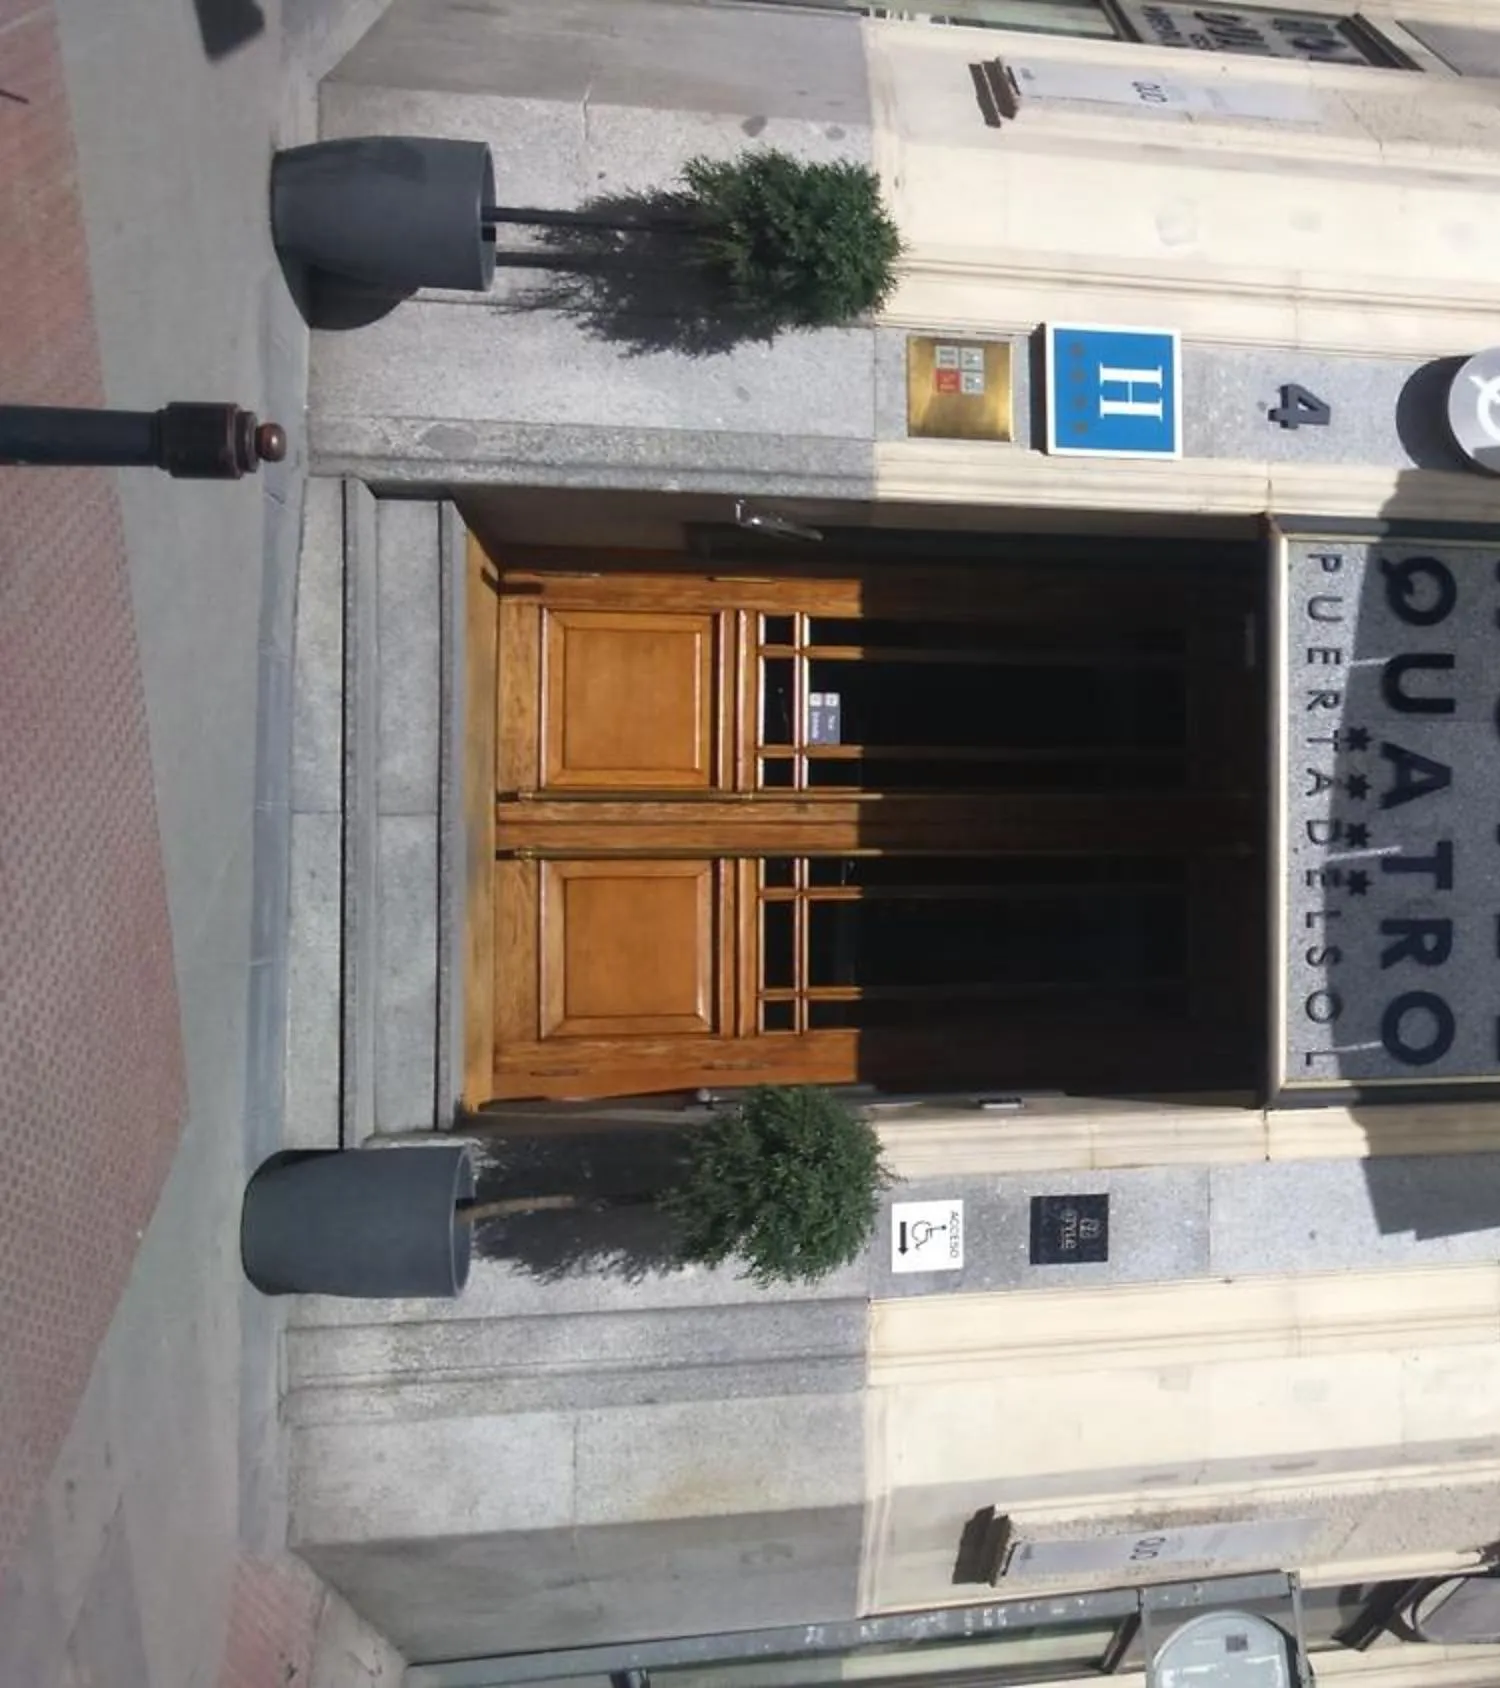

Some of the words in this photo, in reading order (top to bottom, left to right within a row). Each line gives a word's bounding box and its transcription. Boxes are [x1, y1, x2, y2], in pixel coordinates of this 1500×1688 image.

[1099, 361, 1164, 422] H
[1267, 384, 1331, 431] 4
[1378, 556, 1457, 1068] QUATRO
[949, 1210, 960, 1259] ACCESO
